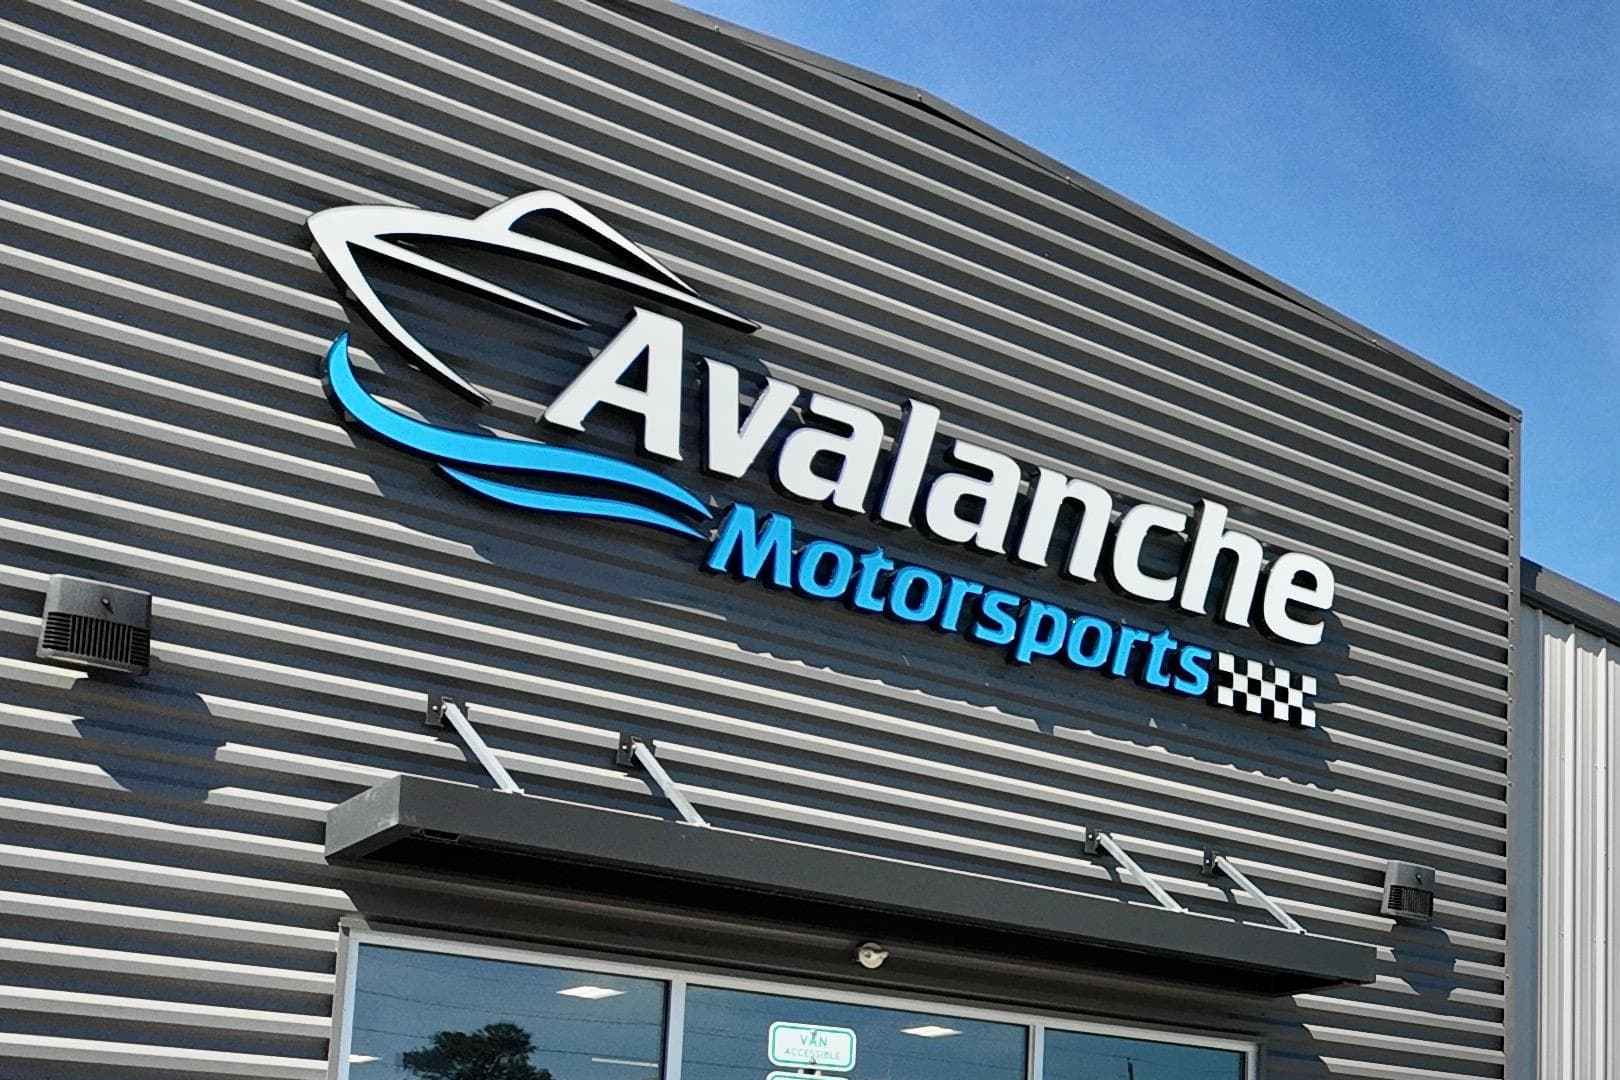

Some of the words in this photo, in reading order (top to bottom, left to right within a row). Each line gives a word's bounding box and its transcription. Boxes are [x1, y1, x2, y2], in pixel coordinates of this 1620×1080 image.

[545, 306, 1335, 645] Avalanche
[706, 502, 1212, 696] Motorsports
[783, 1048, 840, 1060] ACCESSIBLE
[799, 1034, 828, 1047] VAN
